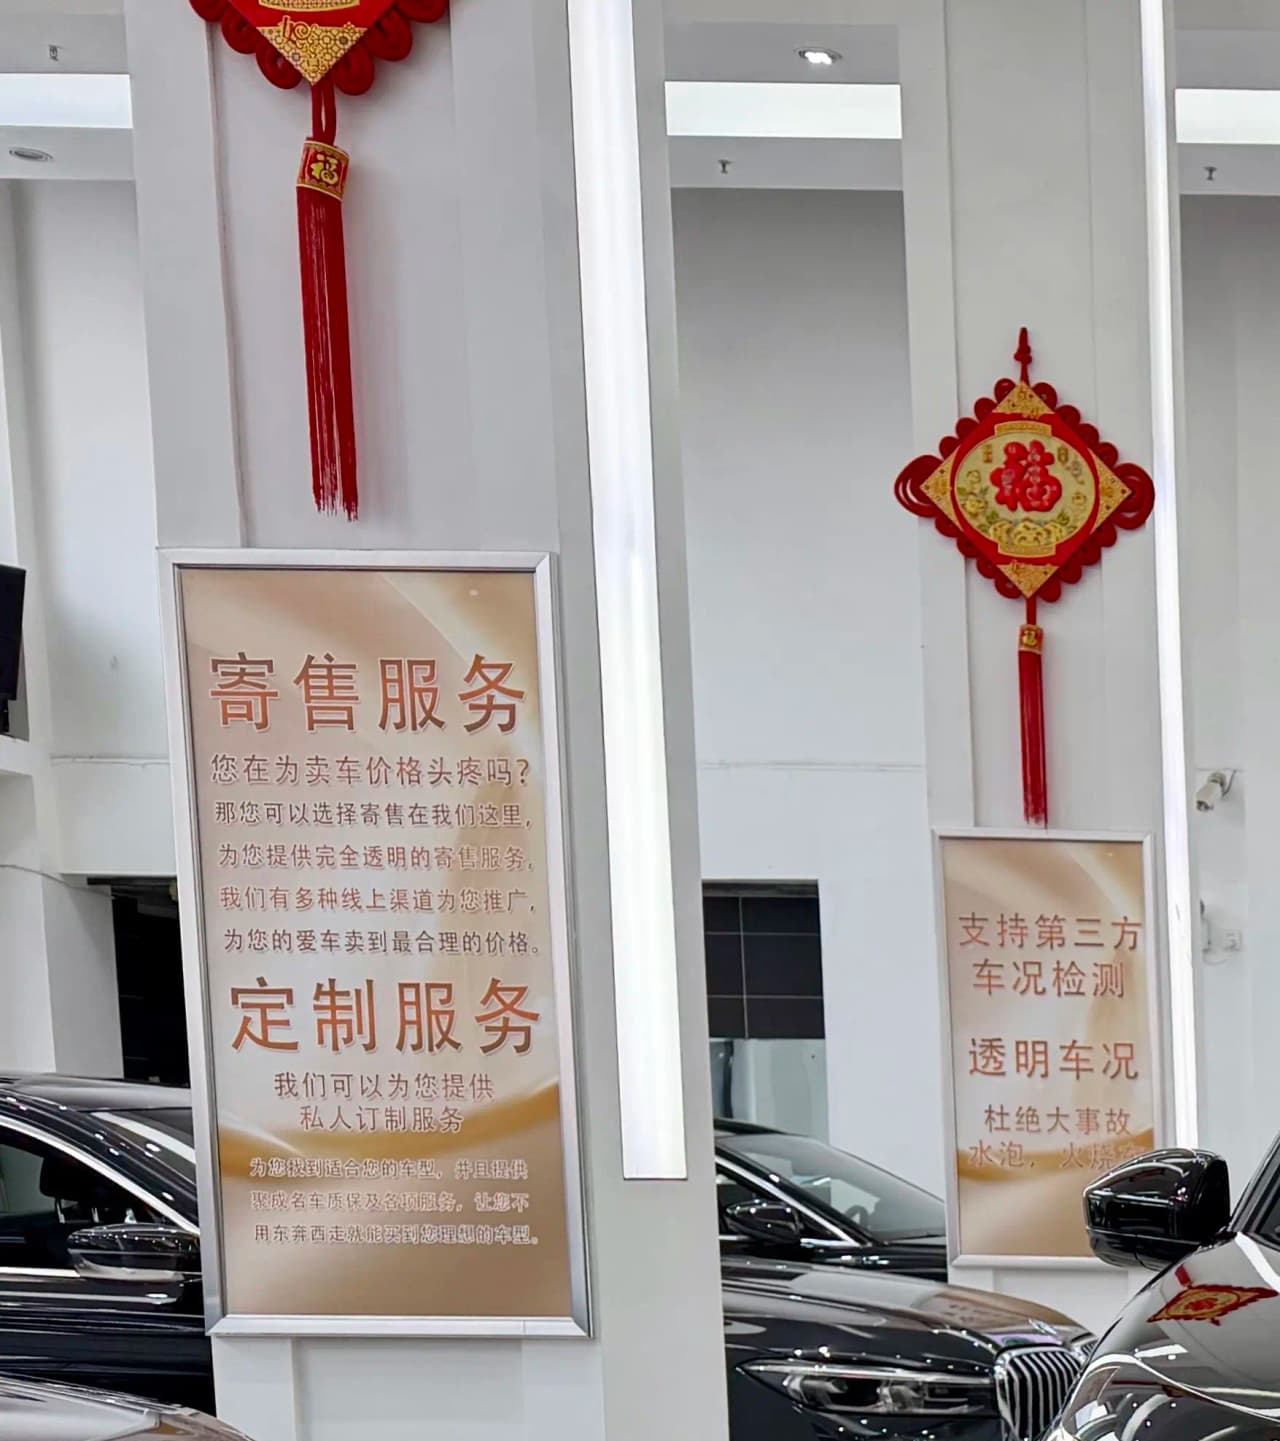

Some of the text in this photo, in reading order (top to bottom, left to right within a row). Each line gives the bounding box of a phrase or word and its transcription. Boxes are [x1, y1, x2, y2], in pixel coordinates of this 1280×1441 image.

[989, 440, 1062, 512] 福
[209, 651, 526, 735] 寄售服务
[957, 911, 1143, 952] 支持第三方
[972, 957, 1126, 999] 车况检测
[231, 975, 541, 1055] 定制服务
[967, 1036, 1140, 1082] 透明车况
[273, 1071, 496, 1101] 我们可以为您提供
[299, 1105, 465, 1135] 私人订制服务
[984, 1103, 1132, 1137] 杜绝大事故
